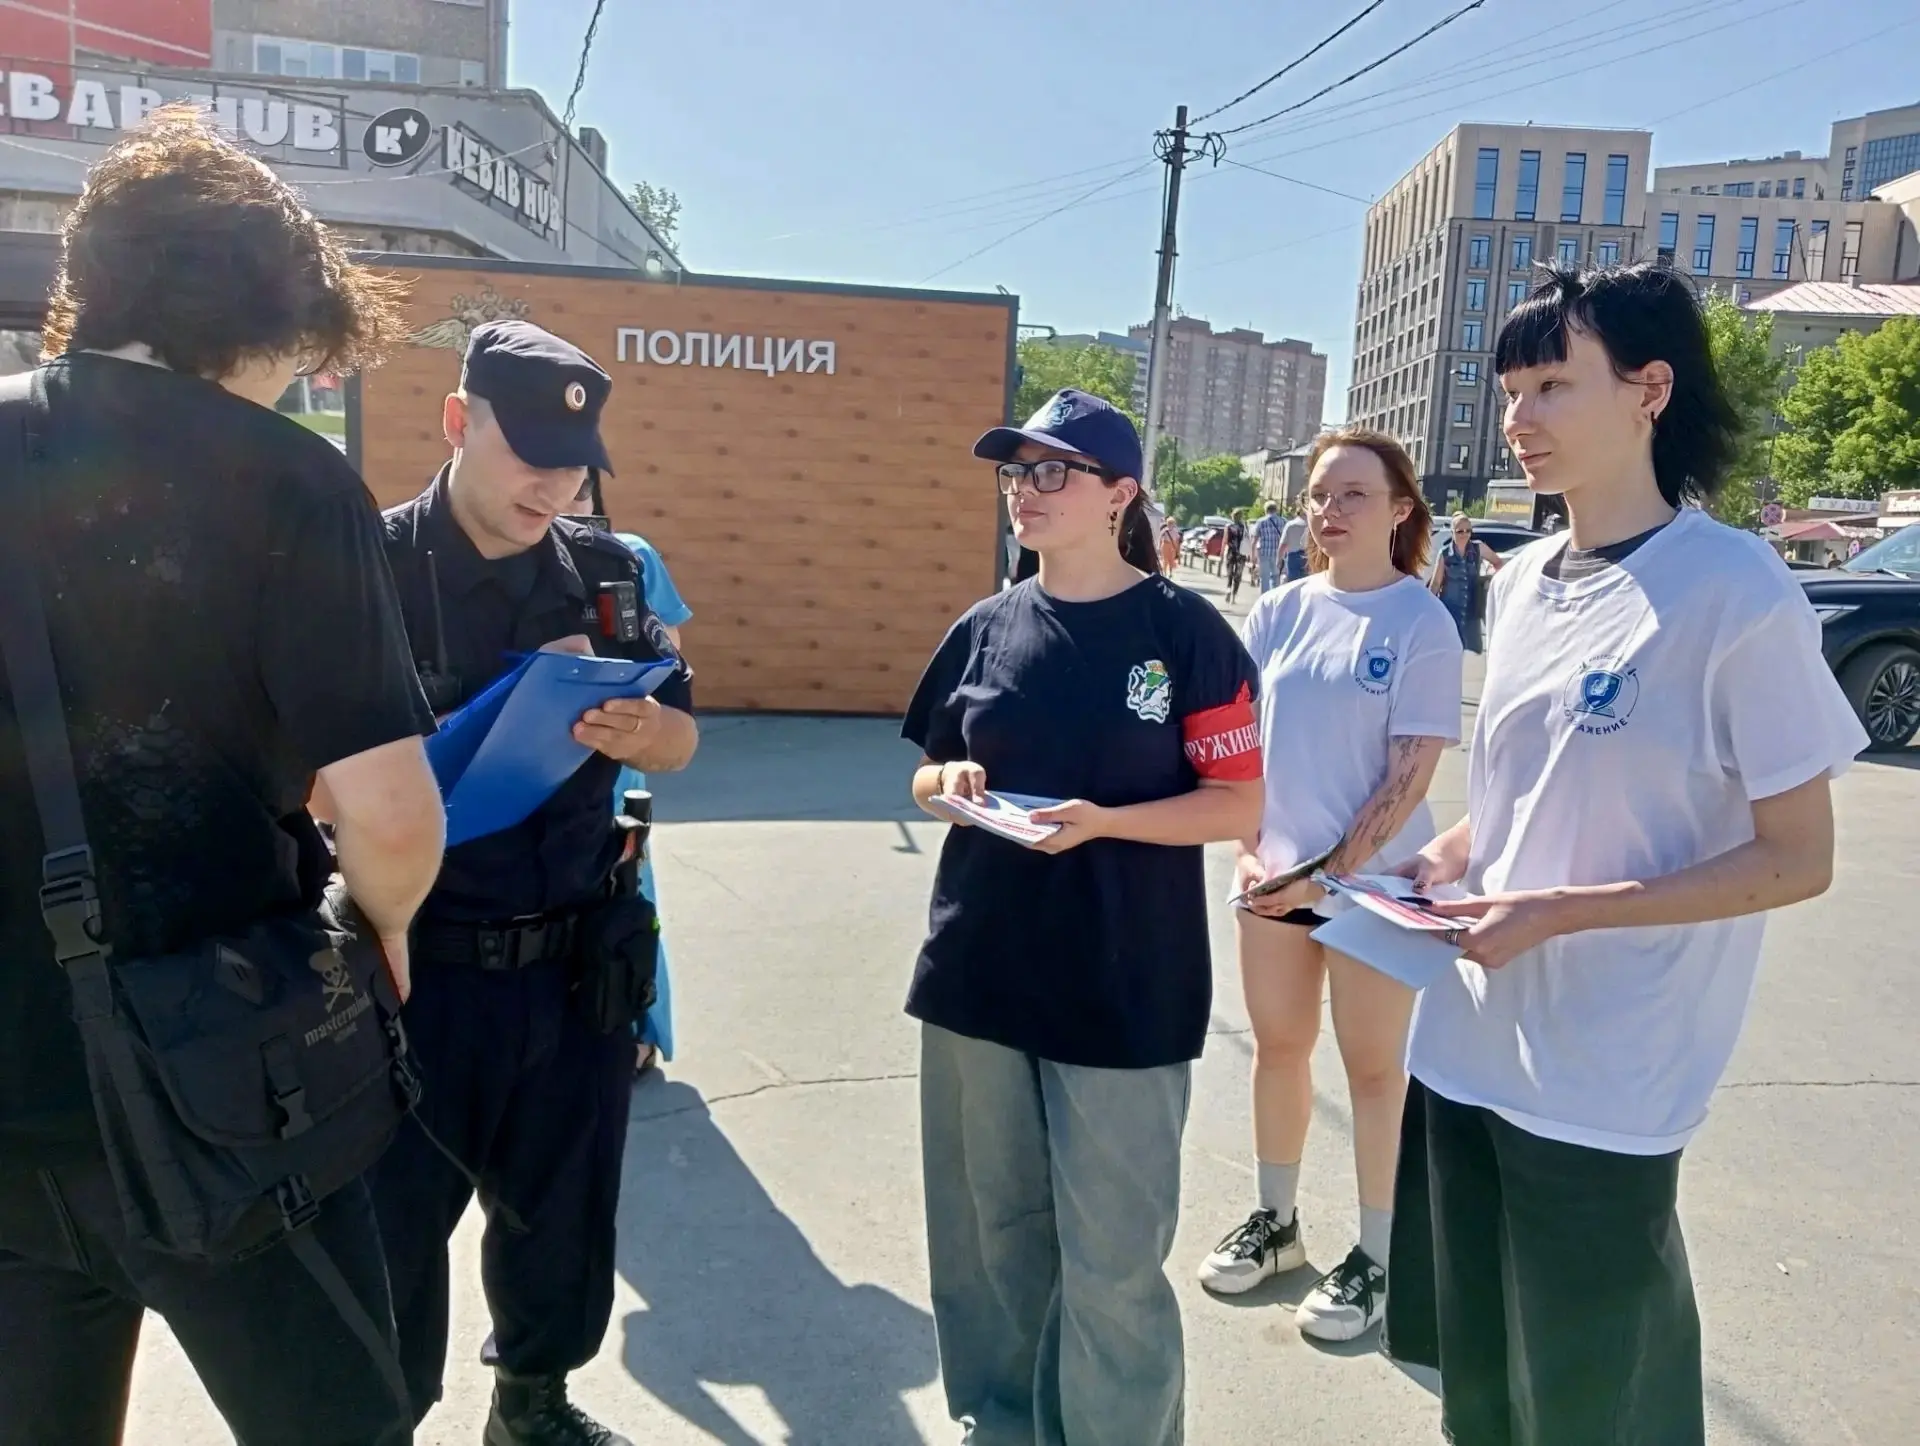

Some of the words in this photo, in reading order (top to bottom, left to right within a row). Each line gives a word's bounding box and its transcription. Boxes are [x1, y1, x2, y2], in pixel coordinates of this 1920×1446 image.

[0, 72, 163, 132] BAB
[447, 123, 520, 208] KEBAB
[524, 176, 561, 232] HUB
[616, 327, 835, 377] ПОЛИЦИЯ
[1564, 709, 1628, 736] ОТАЖЕНИЕ
